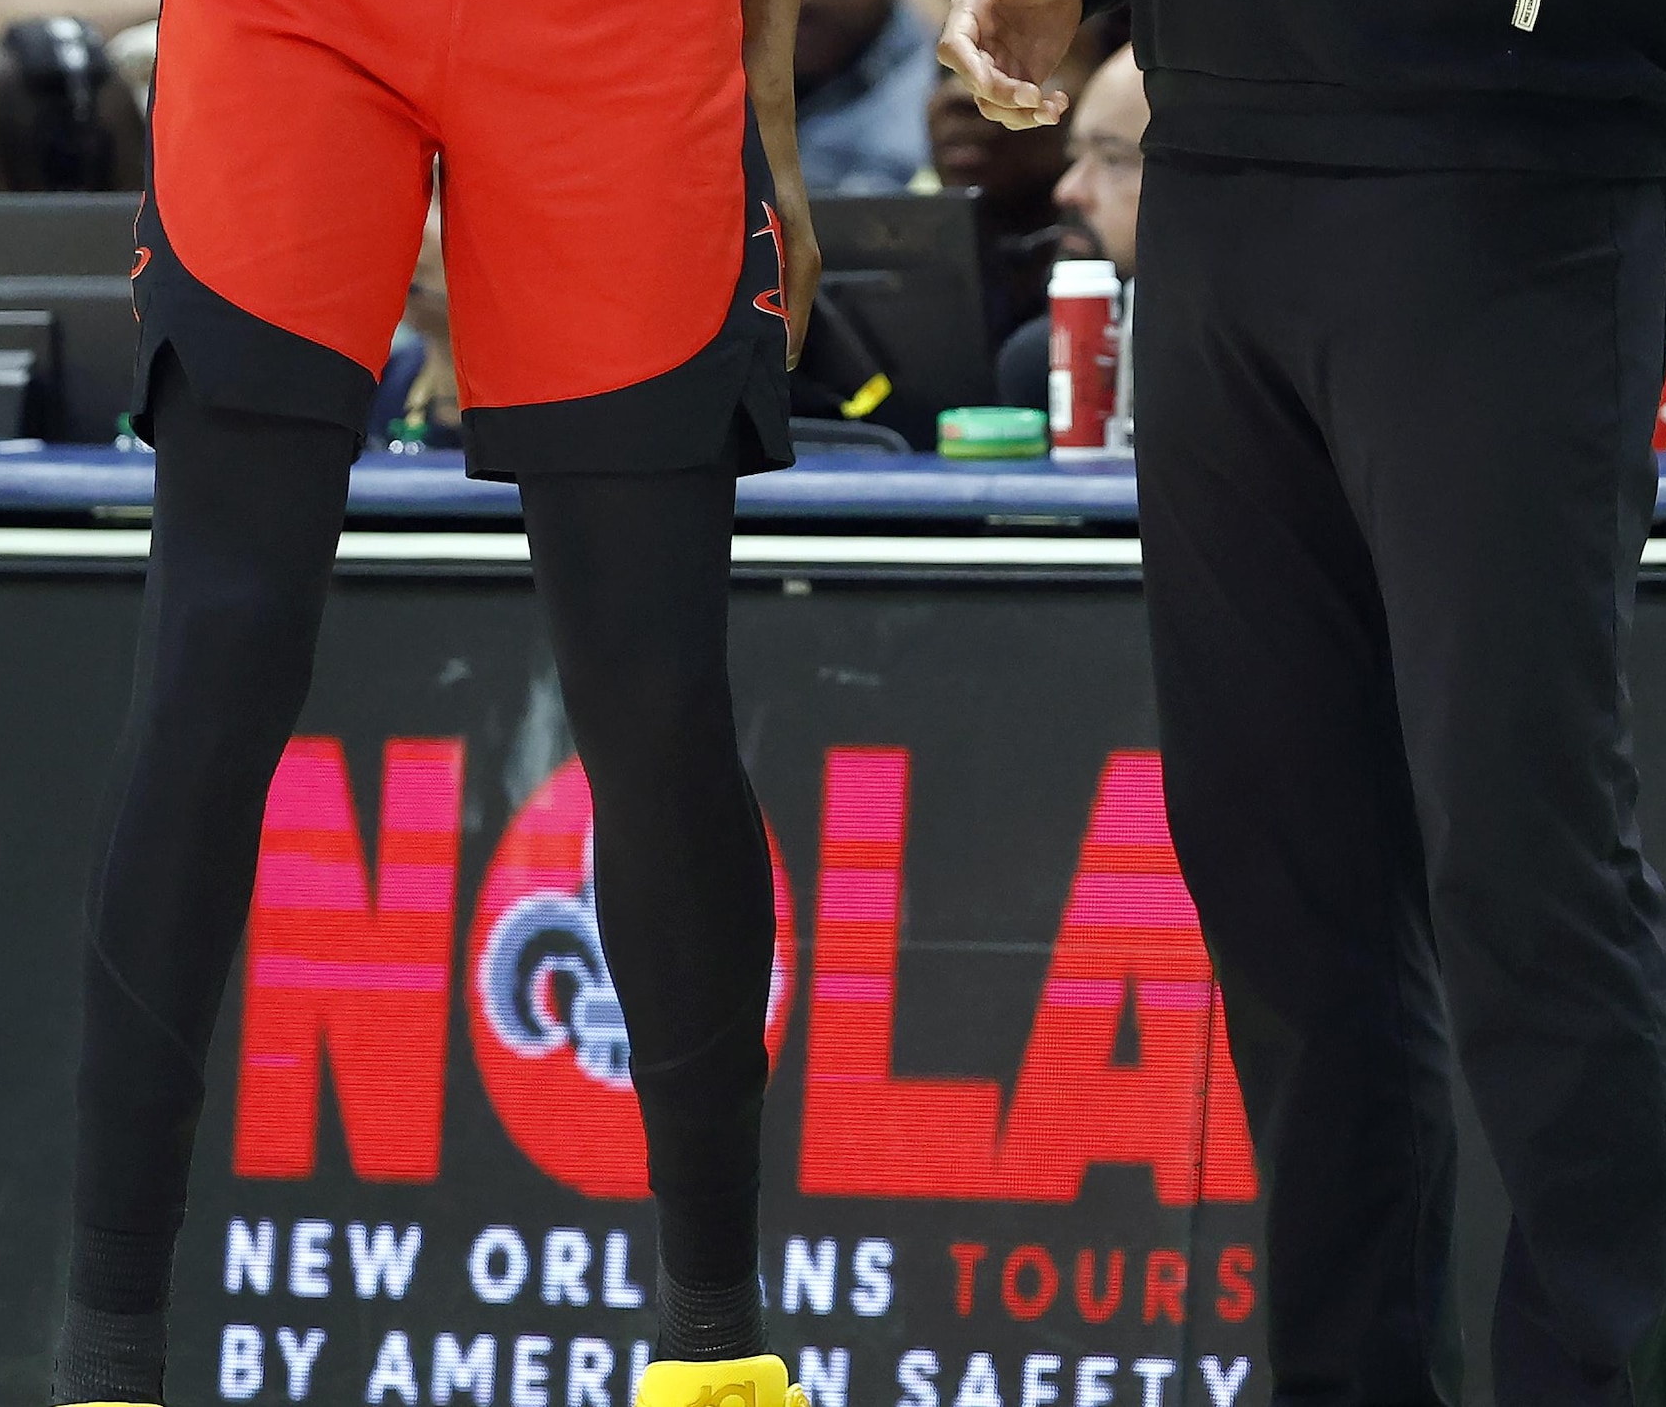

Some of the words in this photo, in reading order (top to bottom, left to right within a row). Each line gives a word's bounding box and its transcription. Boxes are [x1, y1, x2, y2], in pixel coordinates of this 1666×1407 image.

[224, 1218, 423, 1299] NEW
[469, 1225, 893, 1316] ORLNS
[950, 1243, 1256, 1323] TOURS
[219, 1325, 326, 1400] BY
[367, 1331, 849, 1407] AMERIN
[896, 1349, 1251, 1407] SAFETY
